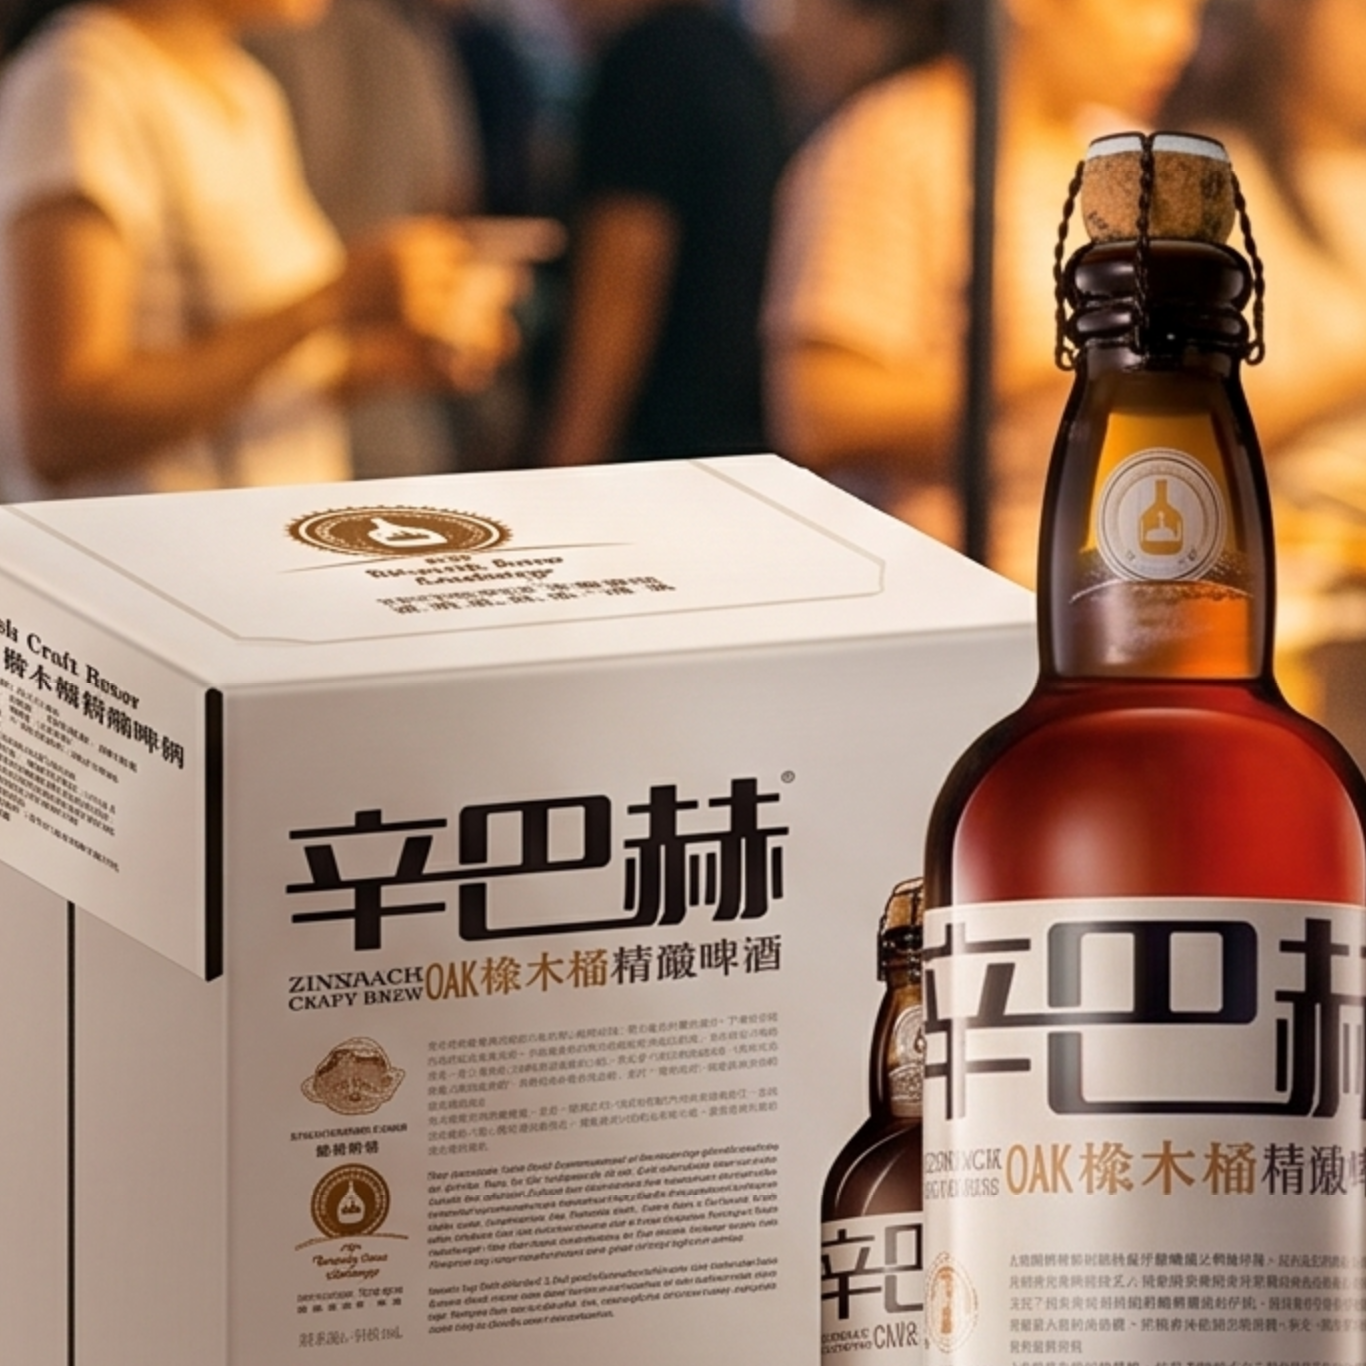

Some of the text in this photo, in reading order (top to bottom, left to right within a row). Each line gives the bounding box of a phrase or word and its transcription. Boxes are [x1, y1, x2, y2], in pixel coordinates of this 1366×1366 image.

[286, 777, 789, 951] 辛巴赫
[426, 960, 479, 1001] OAK
[1006, 1144, 1074, 1195] OAK
